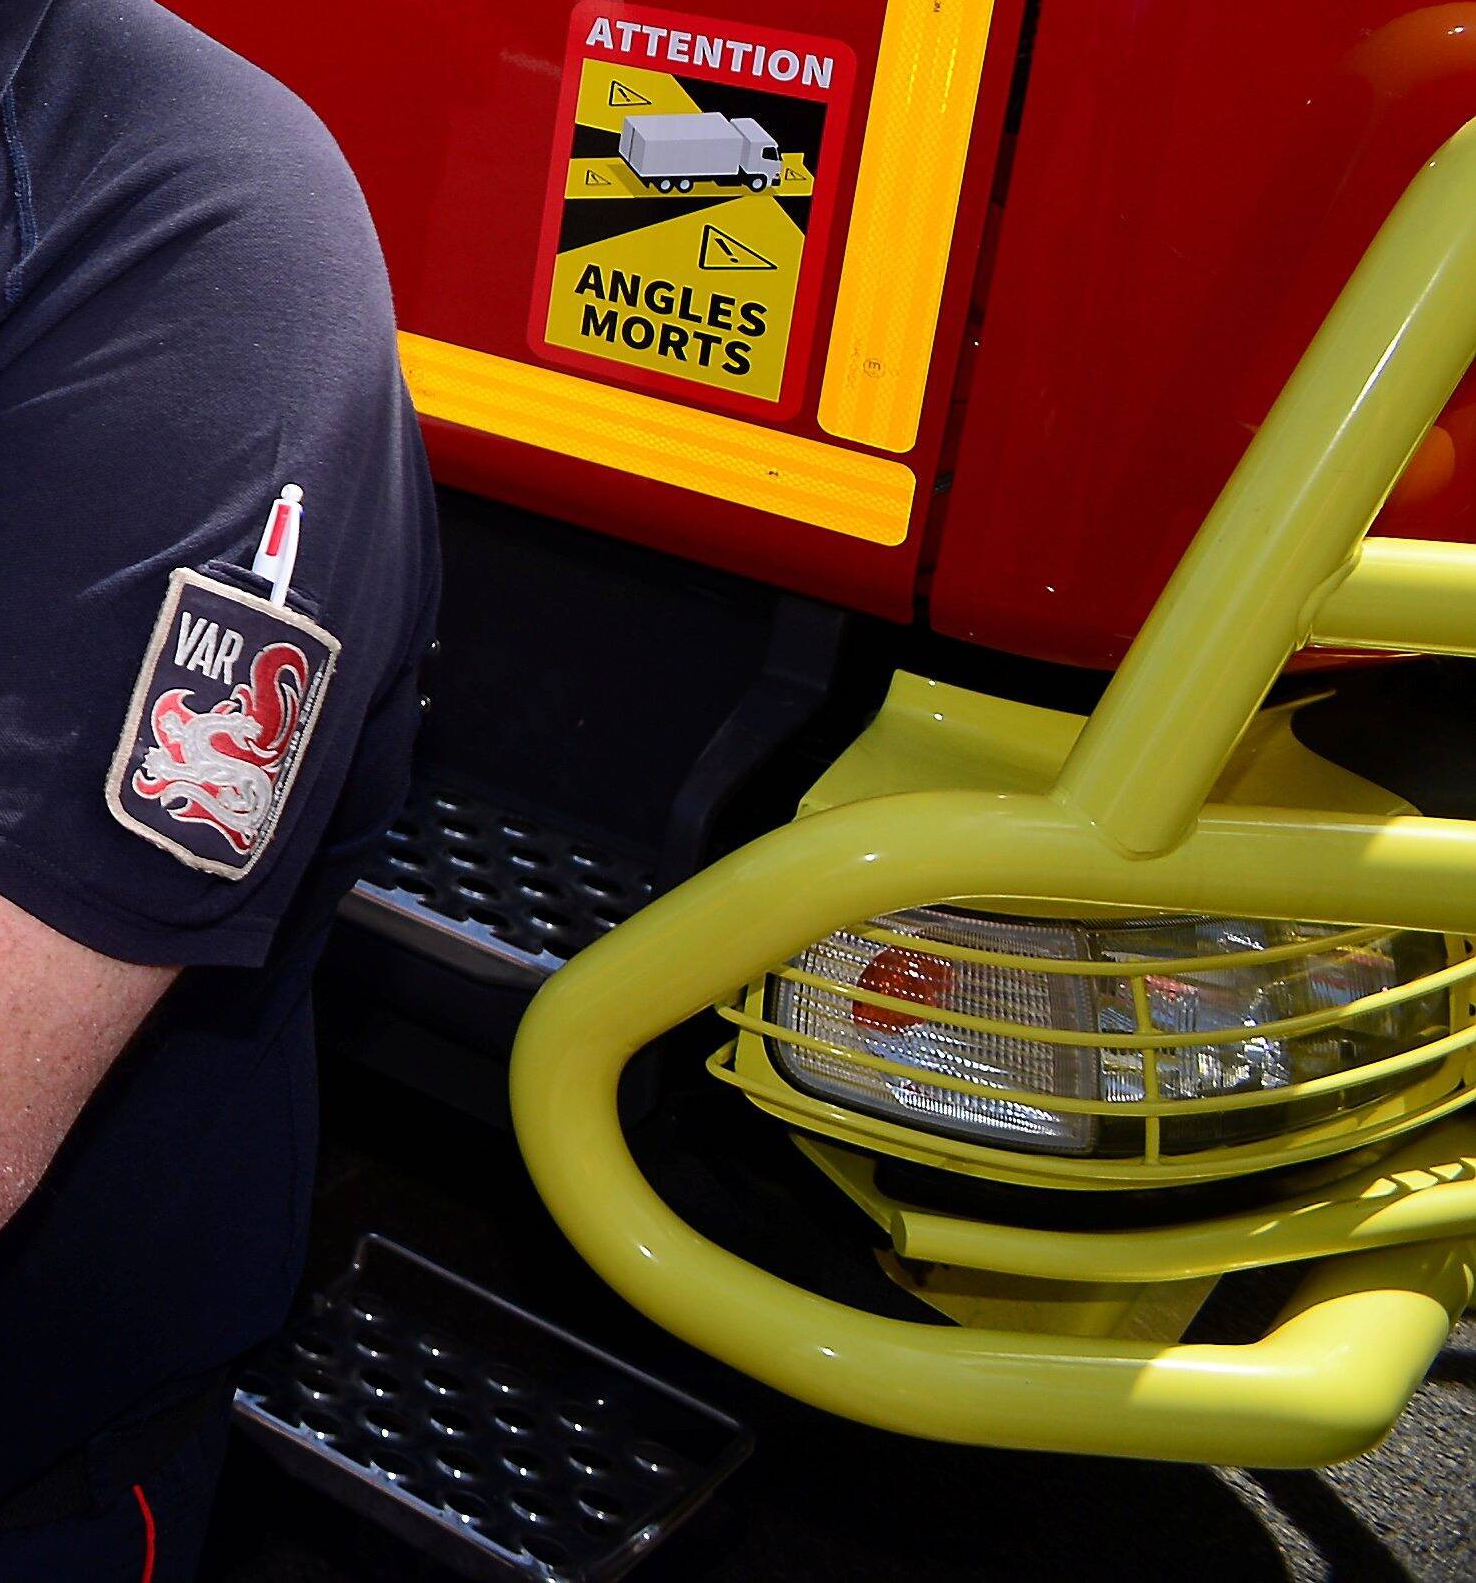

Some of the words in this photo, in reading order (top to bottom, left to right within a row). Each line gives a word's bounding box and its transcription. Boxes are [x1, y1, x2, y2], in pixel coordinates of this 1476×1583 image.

[585, 16, 834, 89] ATTENTION
[574, 263, 769, 338] ANGLES
[580, 303, 753, 376] MORTS
[174, 611, 244, 685] VAR
